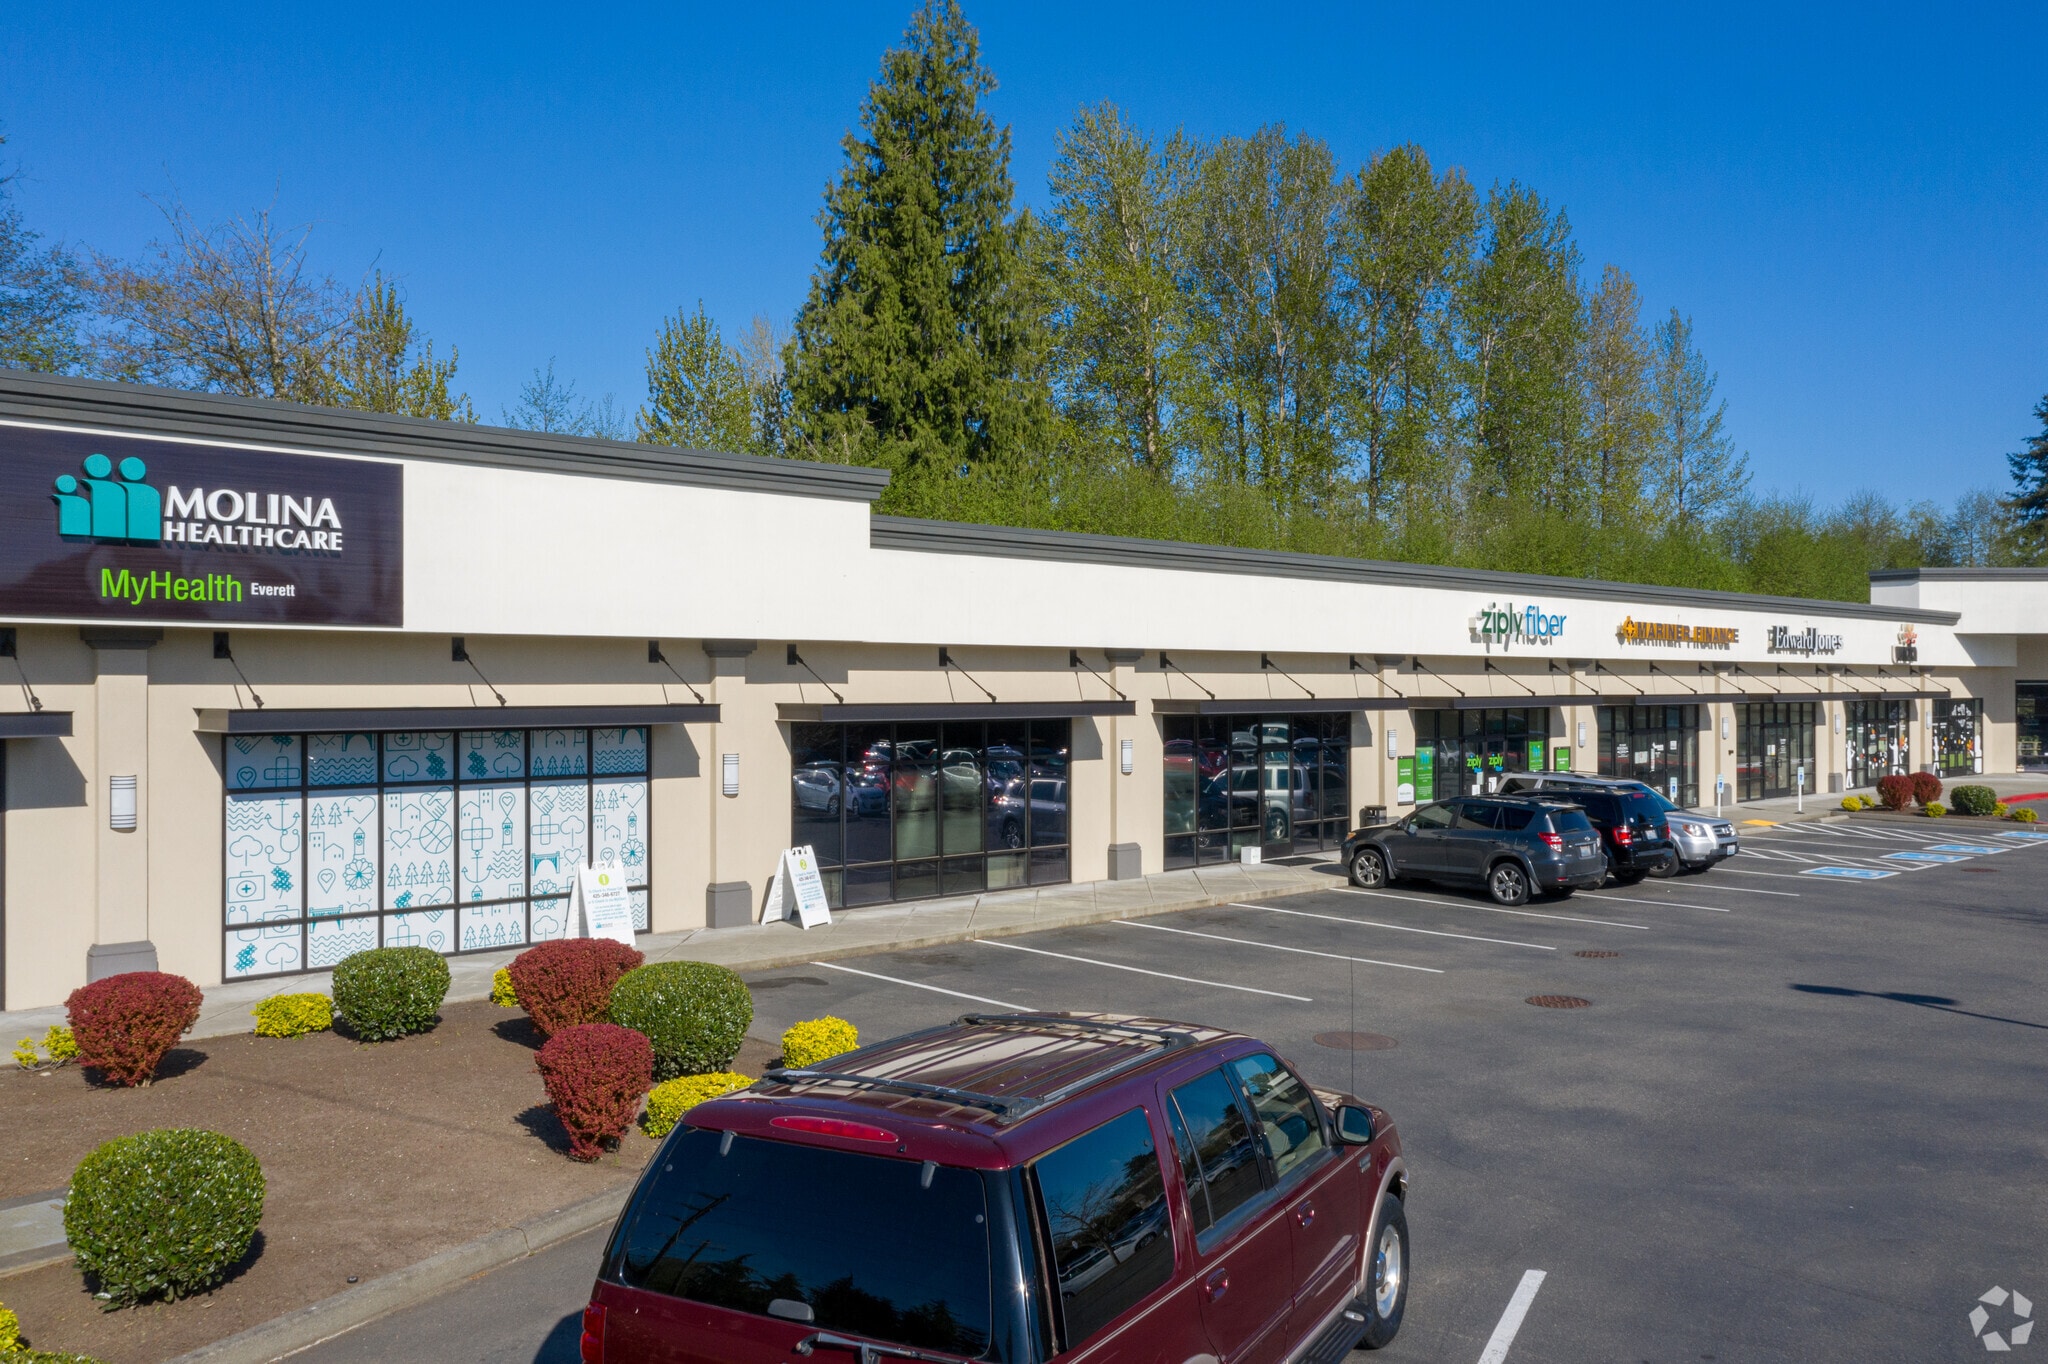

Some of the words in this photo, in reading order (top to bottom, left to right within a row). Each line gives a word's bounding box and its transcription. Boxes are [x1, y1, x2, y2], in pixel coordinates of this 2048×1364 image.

[163, 485, 342, 528] MOLINA
[163, 520, 342, 551] HEALTHCARE
[101, 568, 242, 605] MyHealth
[250, 582, 296, 597] Everett
[1480, 602, 1523, 644] ziply
[1525, 605, 1567, 636] fiber
[1635, 621, 1690, 641] MARINER
[1693, 626, 1739, 643] FINANCE
[1775, 625, 1813, 649] Edward
[1813, 628, 1843, 653] Jones
